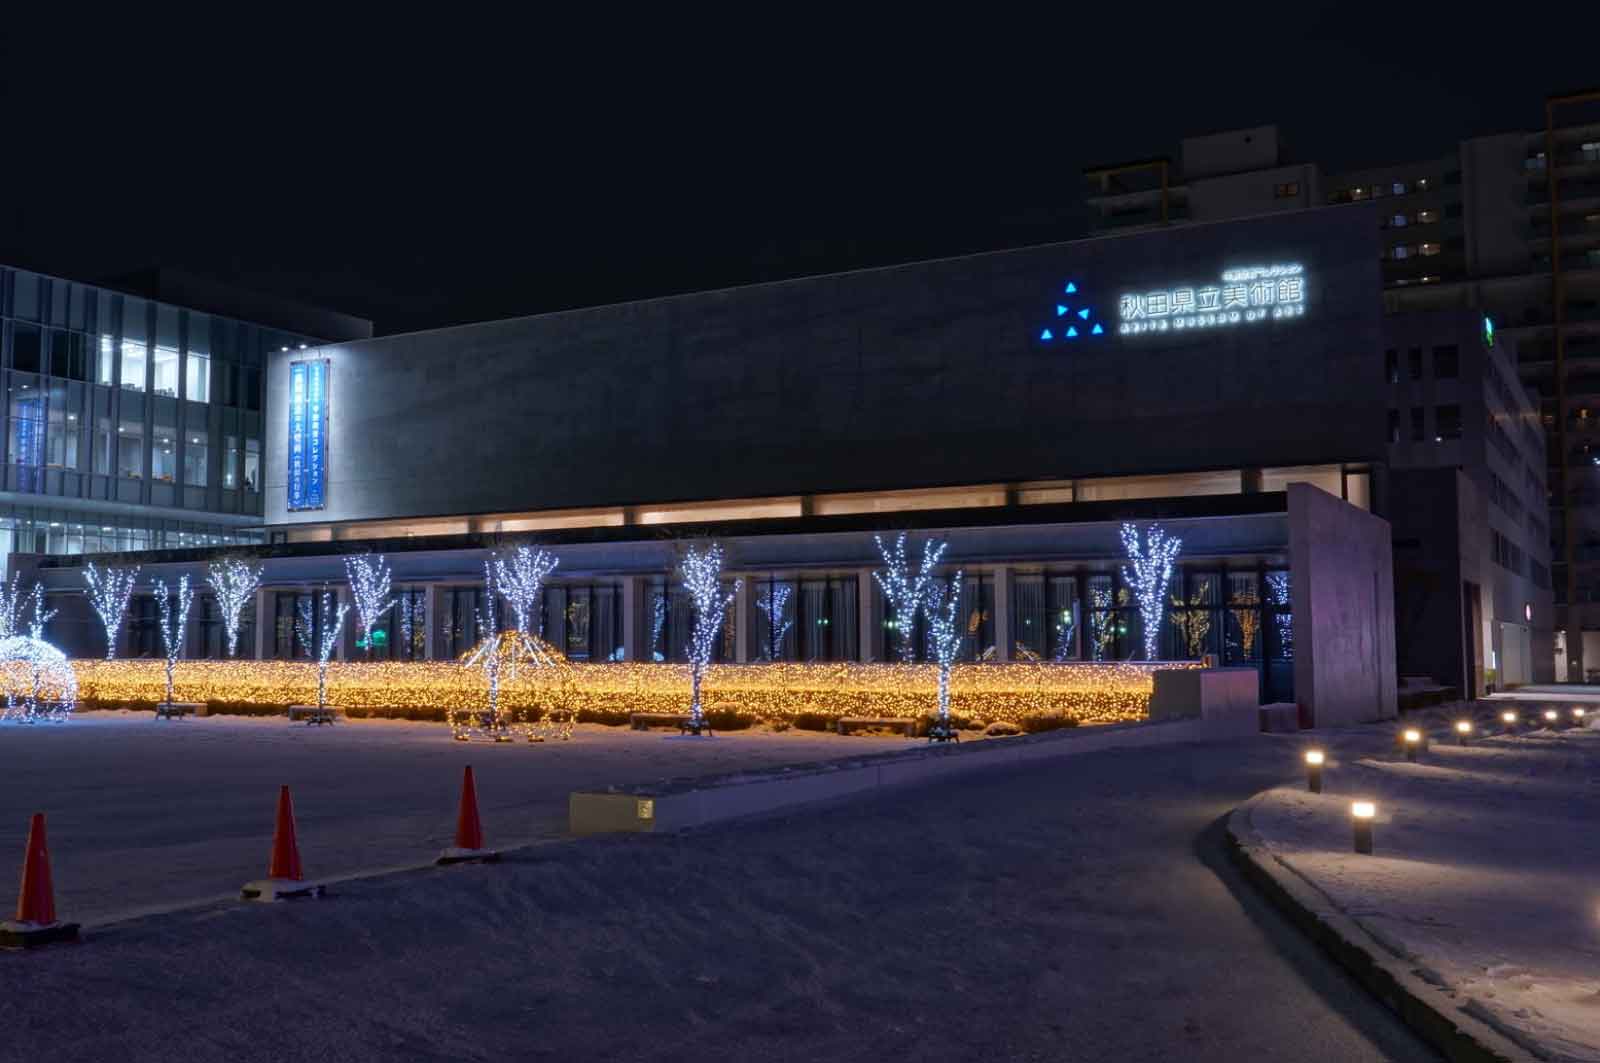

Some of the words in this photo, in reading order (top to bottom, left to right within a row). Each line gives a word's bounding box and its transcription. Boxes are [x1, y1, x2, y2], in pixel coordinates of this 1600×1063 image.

[1119, 278, 1304, 320] 秋田県立美術館
